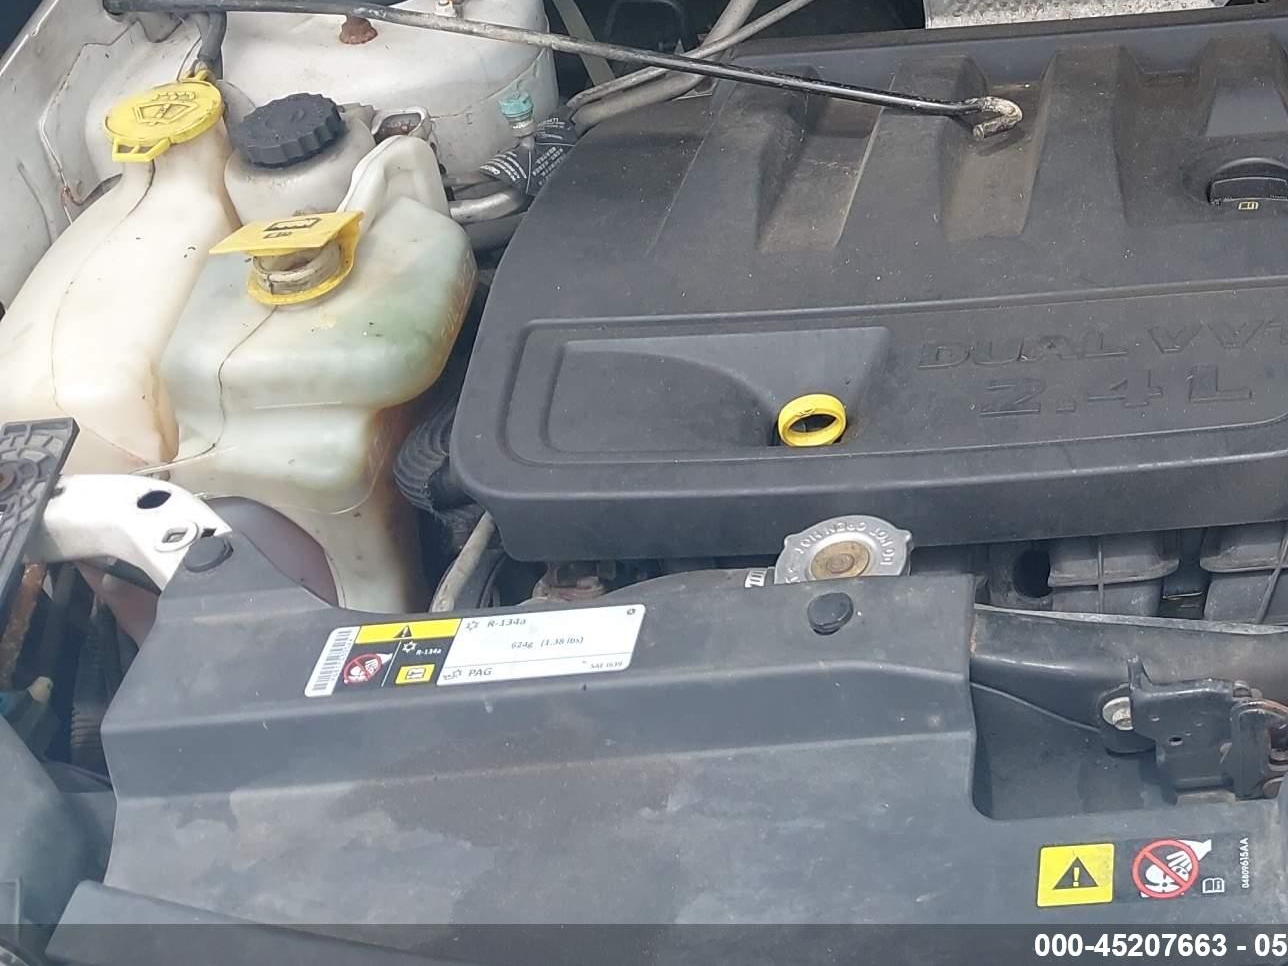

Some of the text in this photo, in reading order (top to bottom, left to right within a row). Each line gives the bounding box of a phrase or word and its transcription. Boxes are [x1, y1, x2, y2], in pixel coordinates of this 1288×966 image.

[918, 333, 1128, 369] DUAL
[979, 364, 1251, 417] 2.4L
[487, 618, 527, 628] R-134a
[540, 638, 565, 648] (1.38
[566, 636, 584, 645] lbs)
[468, 667, 493, 677] PAG
